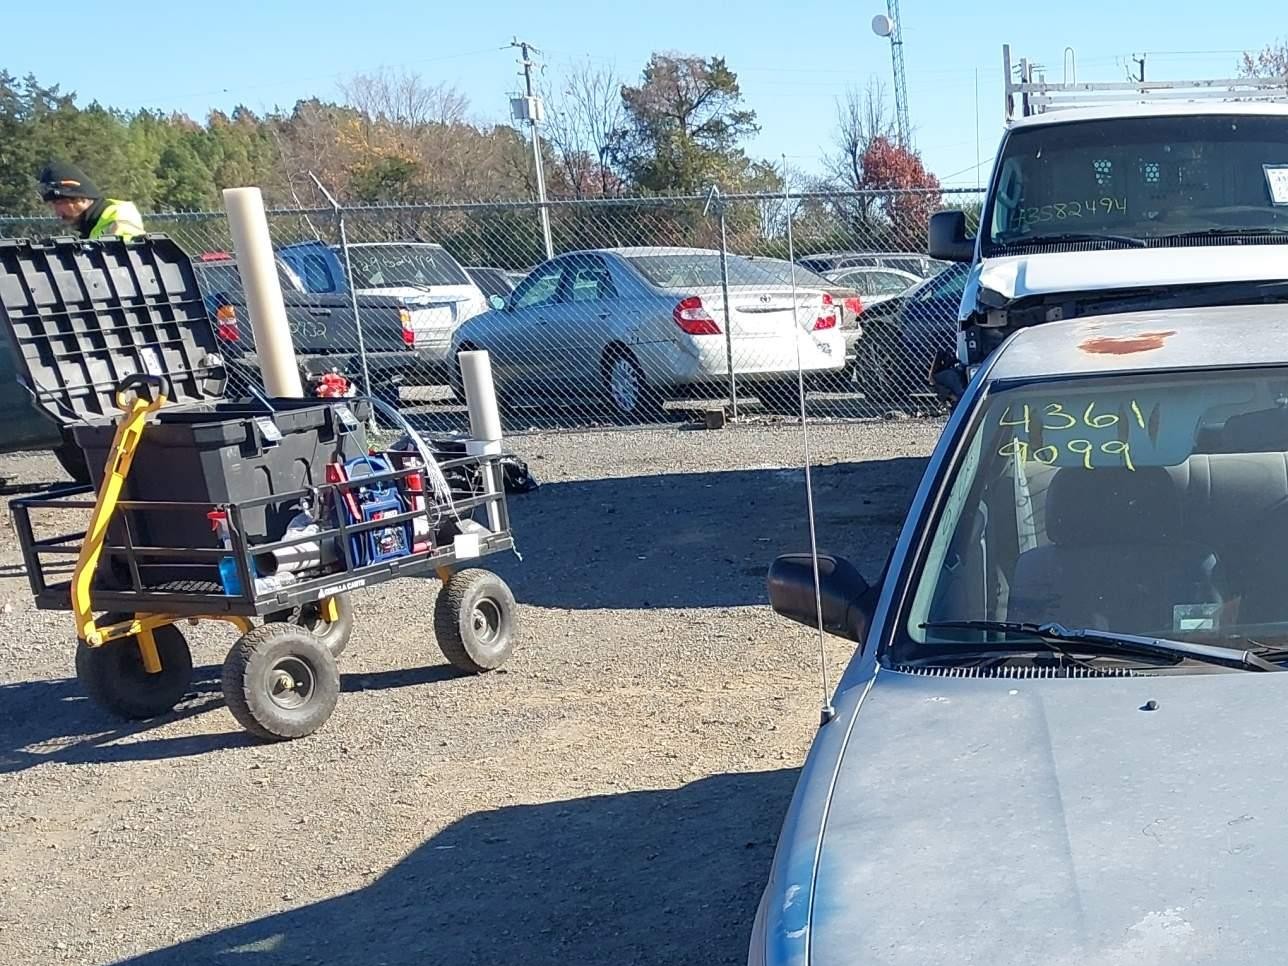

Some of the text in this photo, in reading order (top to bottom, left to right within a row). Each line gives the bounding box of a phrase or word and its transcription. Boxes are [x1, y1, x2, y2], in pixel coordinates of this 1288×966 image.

[1010, 198, 1127, 230] 43582494
[999, 400, 1145, 433] 4361
[998, 439, 1136, 472] 9099
